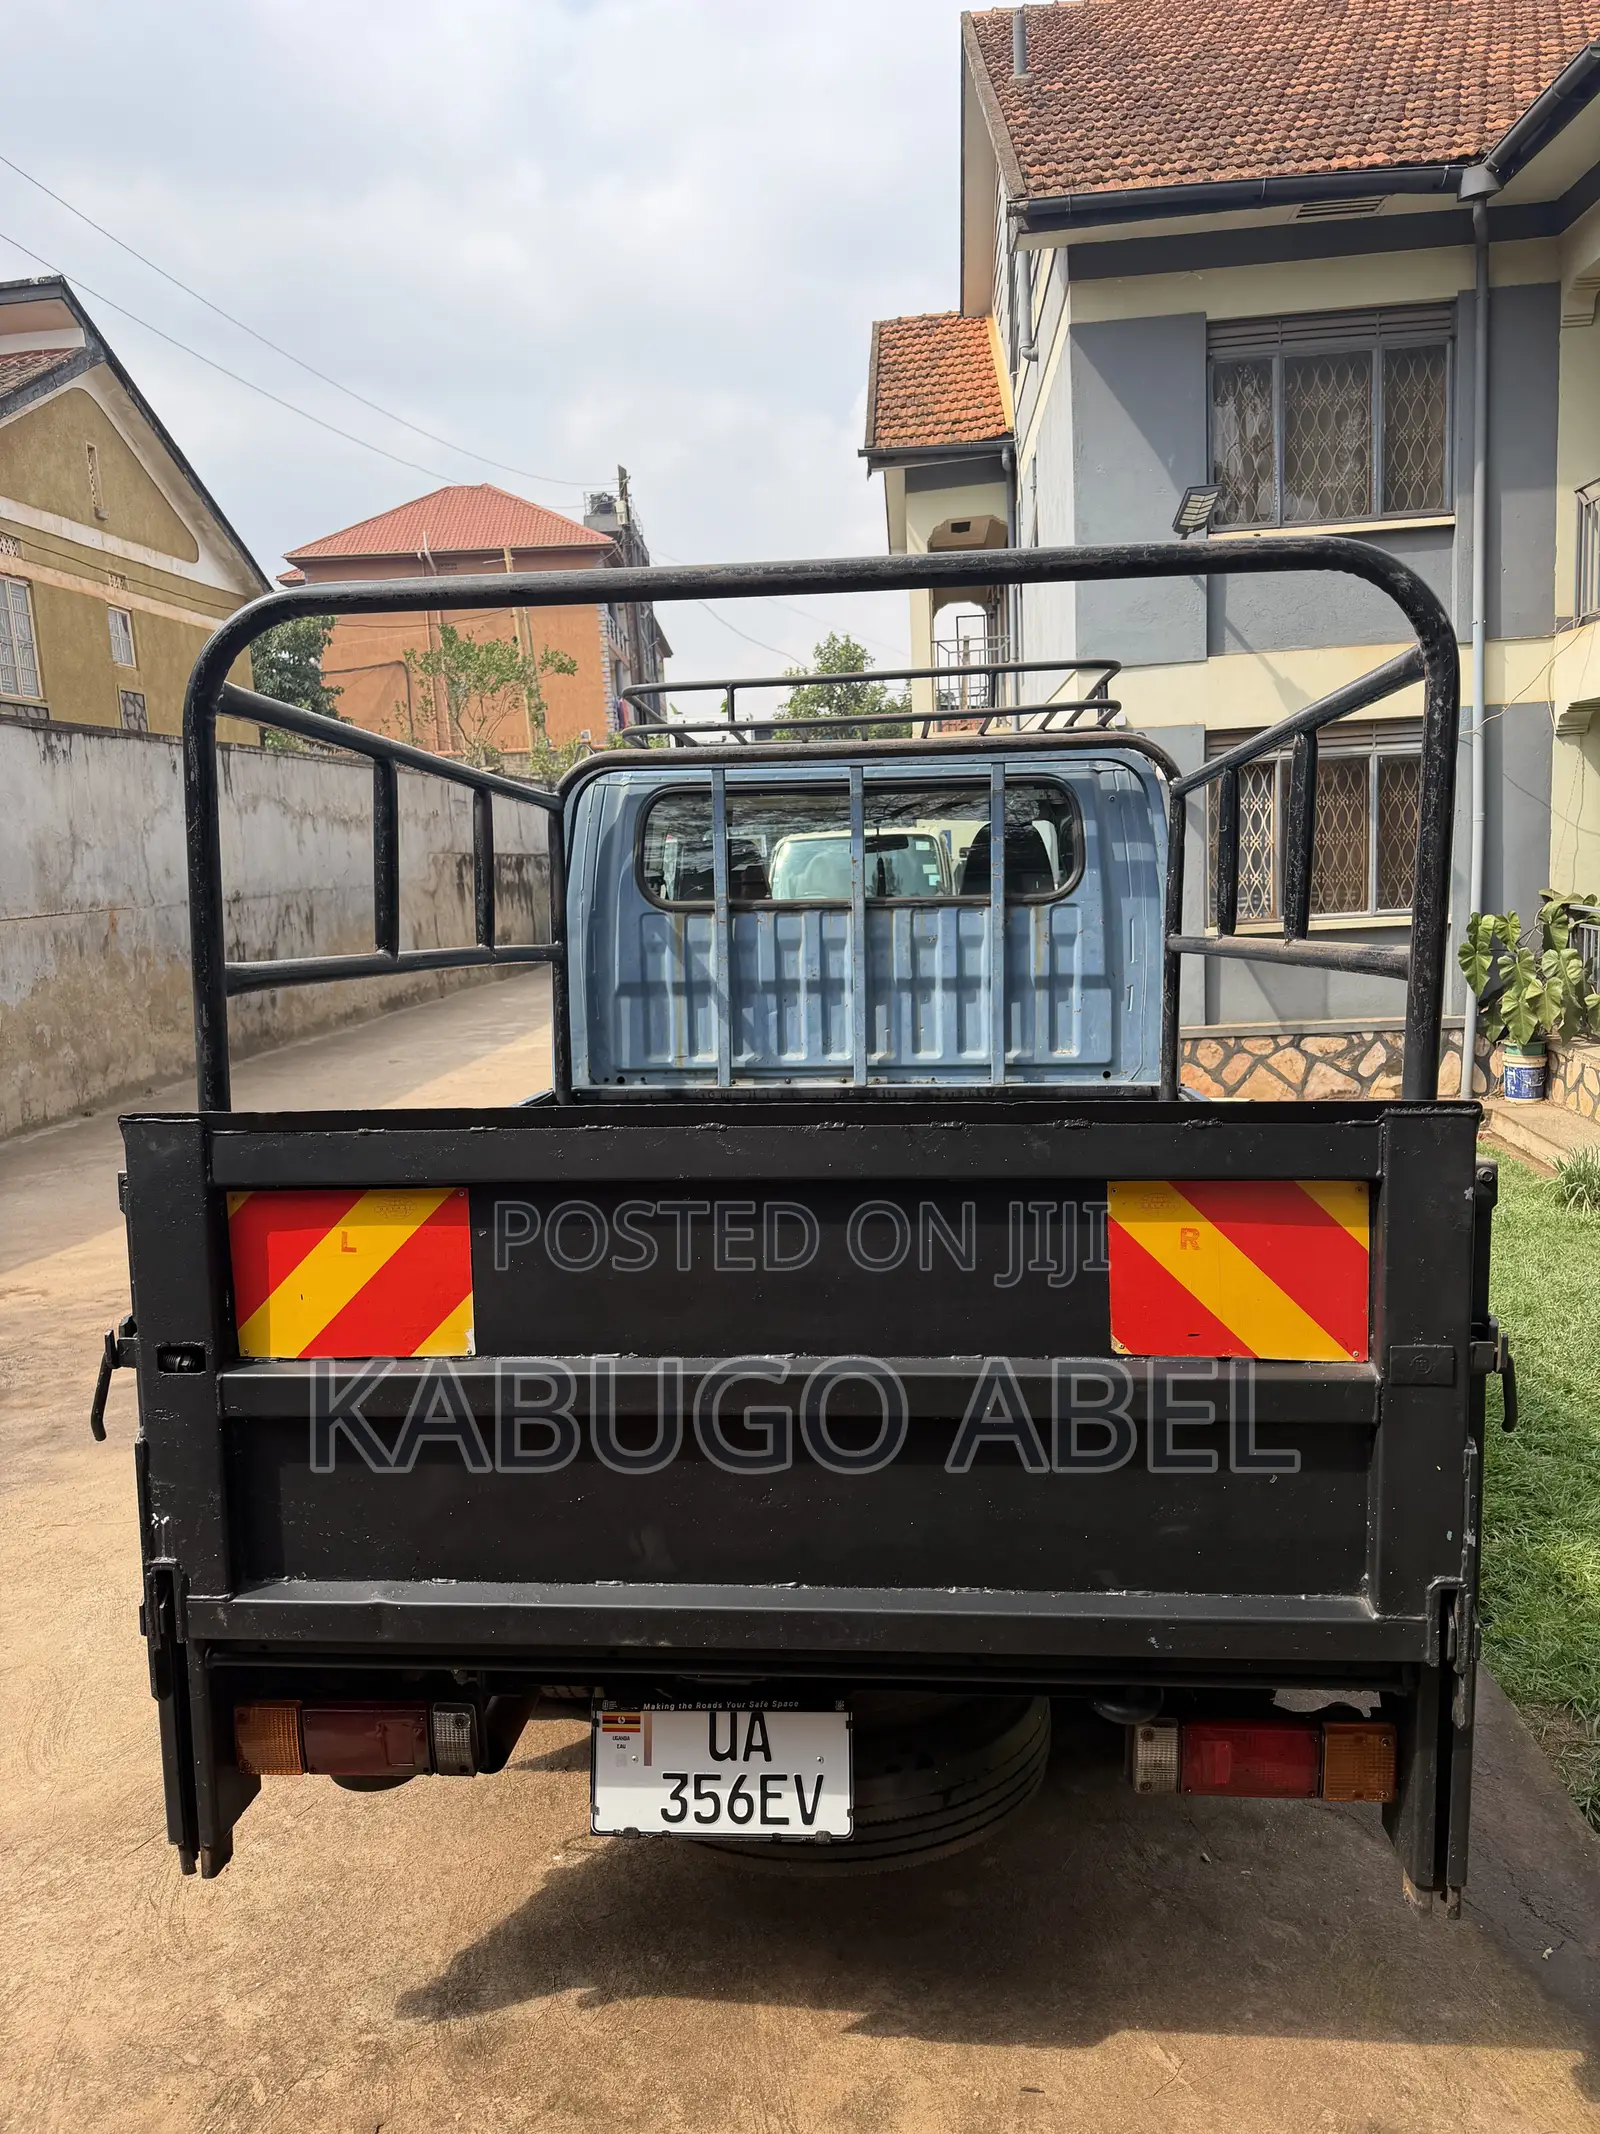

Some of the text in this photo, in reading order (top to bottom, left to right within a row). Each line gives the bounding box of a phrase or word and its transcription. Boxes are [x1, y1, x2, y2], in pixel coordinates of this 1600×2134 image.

[341, 1230, 357, 1253] L
[1180, 1227, 1201, 1250] R
[643, 1702, 675, 1711] Making
[678, 1702, 693, 1710] the
[696, 1701, 722, 1710] Roads
[726, 1701, 746, 1709] Your
[749, 1700, 768, 1708] Safe
[772, 1700, 799, 1708] Space
[708, 1712, 772, 1762] UA
[660, 1772, 824, 1826] 356EV
